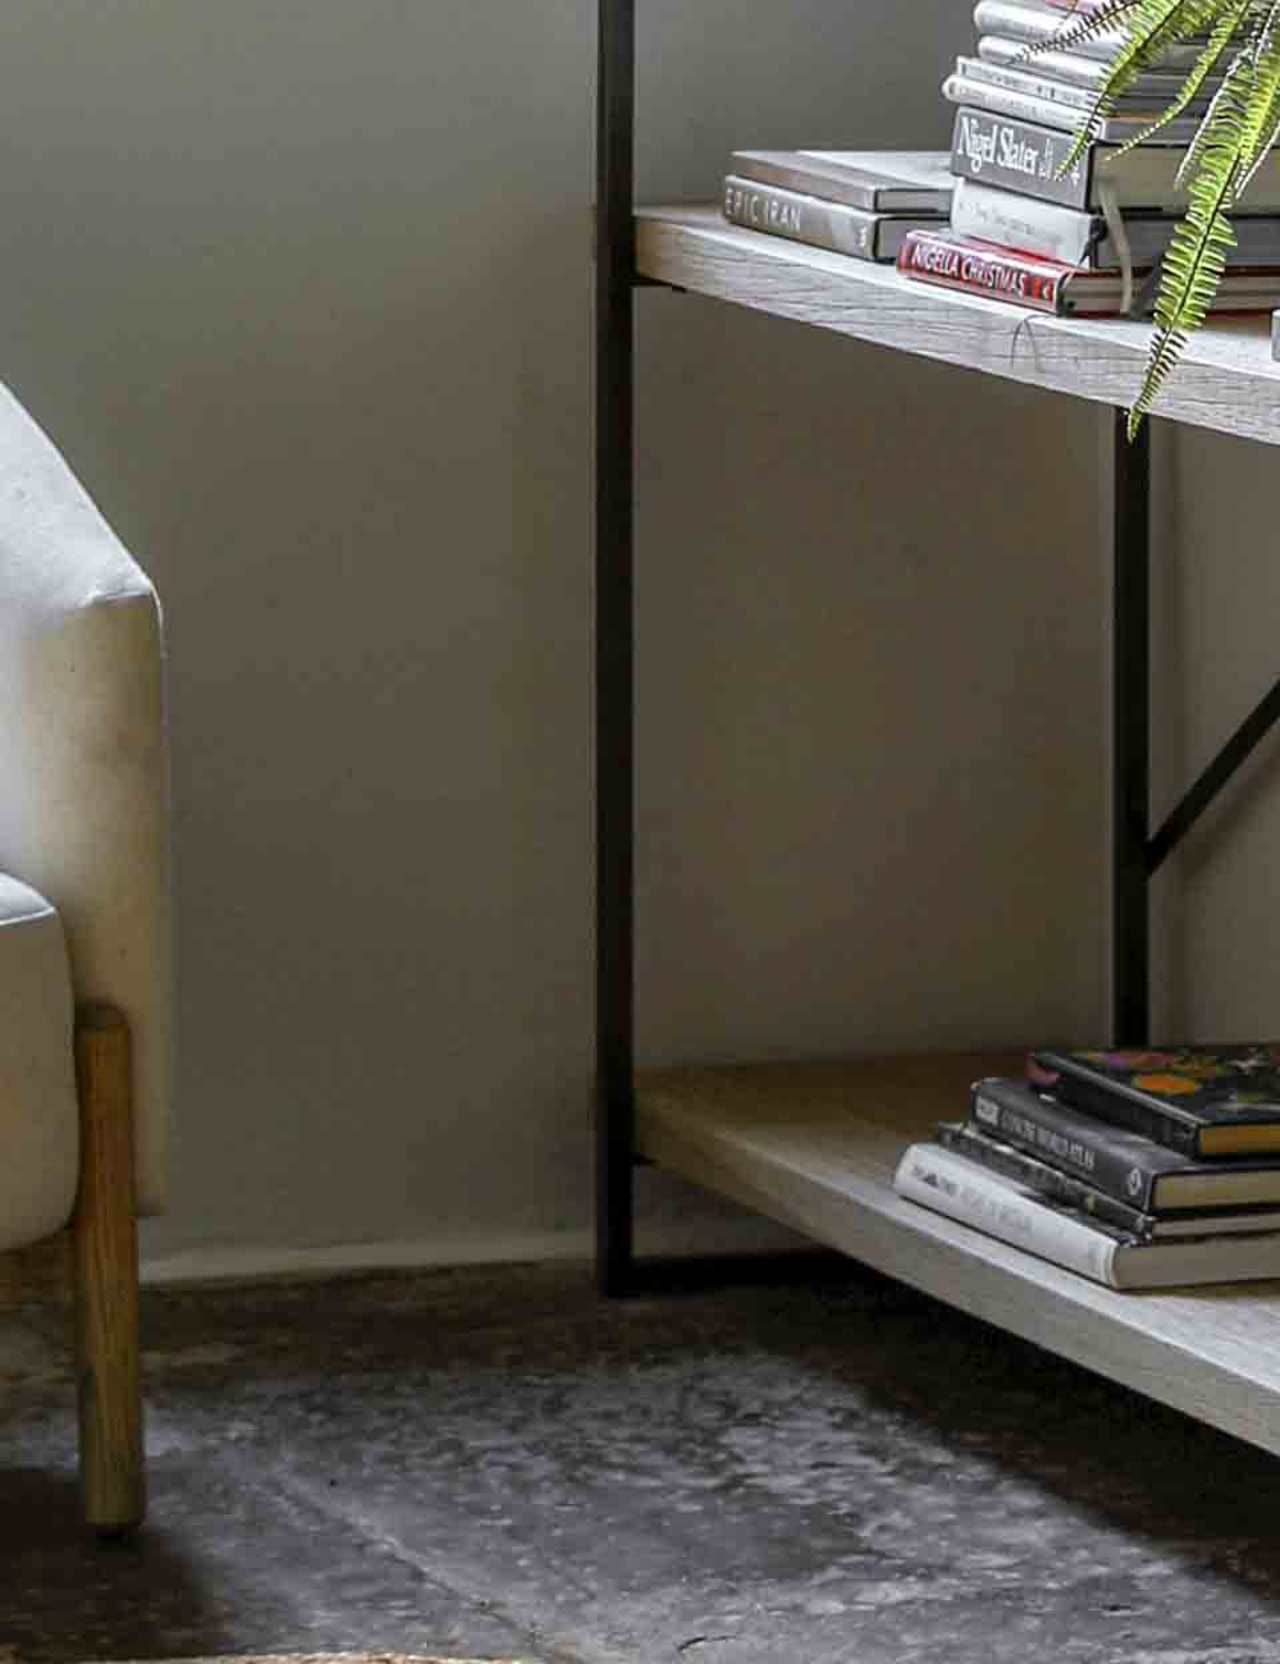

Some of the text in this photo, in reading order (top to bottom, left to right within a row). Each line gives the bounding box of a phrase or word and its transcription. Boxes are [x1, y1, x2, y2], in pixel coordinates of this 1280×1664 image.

[957, 115, 998, 174] Nigel
[998, 127, 1039, 176] Slater
[724, 187, 801, 231] EPIC IRAN
[910, 242, 1027, 299] NIGELLA CHRISTMAS
